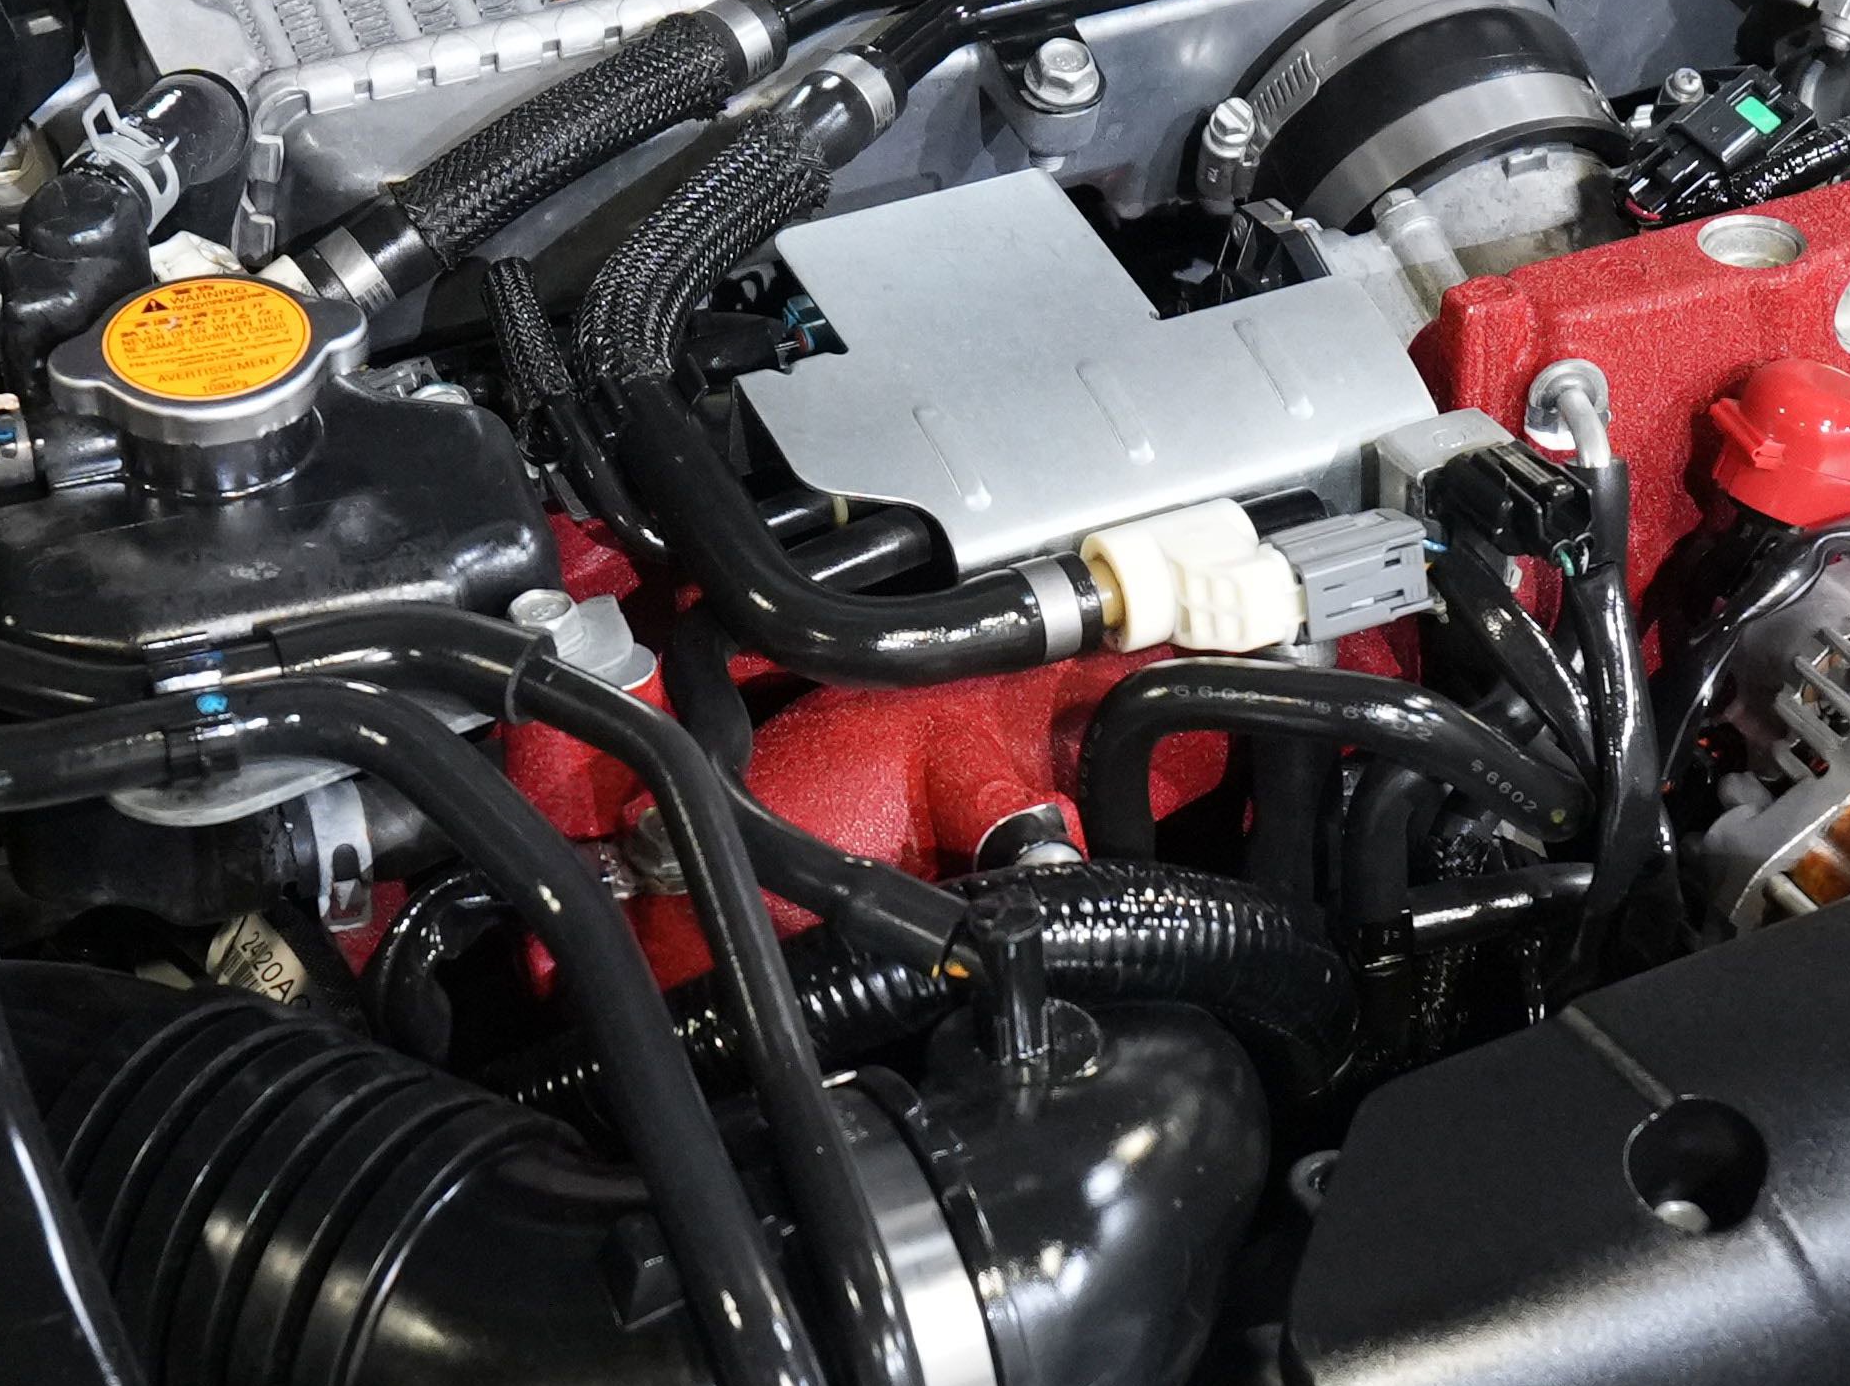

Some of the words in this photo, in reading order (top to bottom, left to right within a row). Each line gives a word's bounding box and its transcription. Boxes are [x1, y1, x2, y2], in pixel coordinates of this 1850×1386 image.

[169, 286, 248, 305] WARNING
[121, 331, 166, 346] NEVER
[170, 327, 207, 341] OPEN
[213, 319, 254, 332] WHEN
[259, 314, 284, 325] HOT
[157, 355, 278, 383] AVERTISSEMENT
